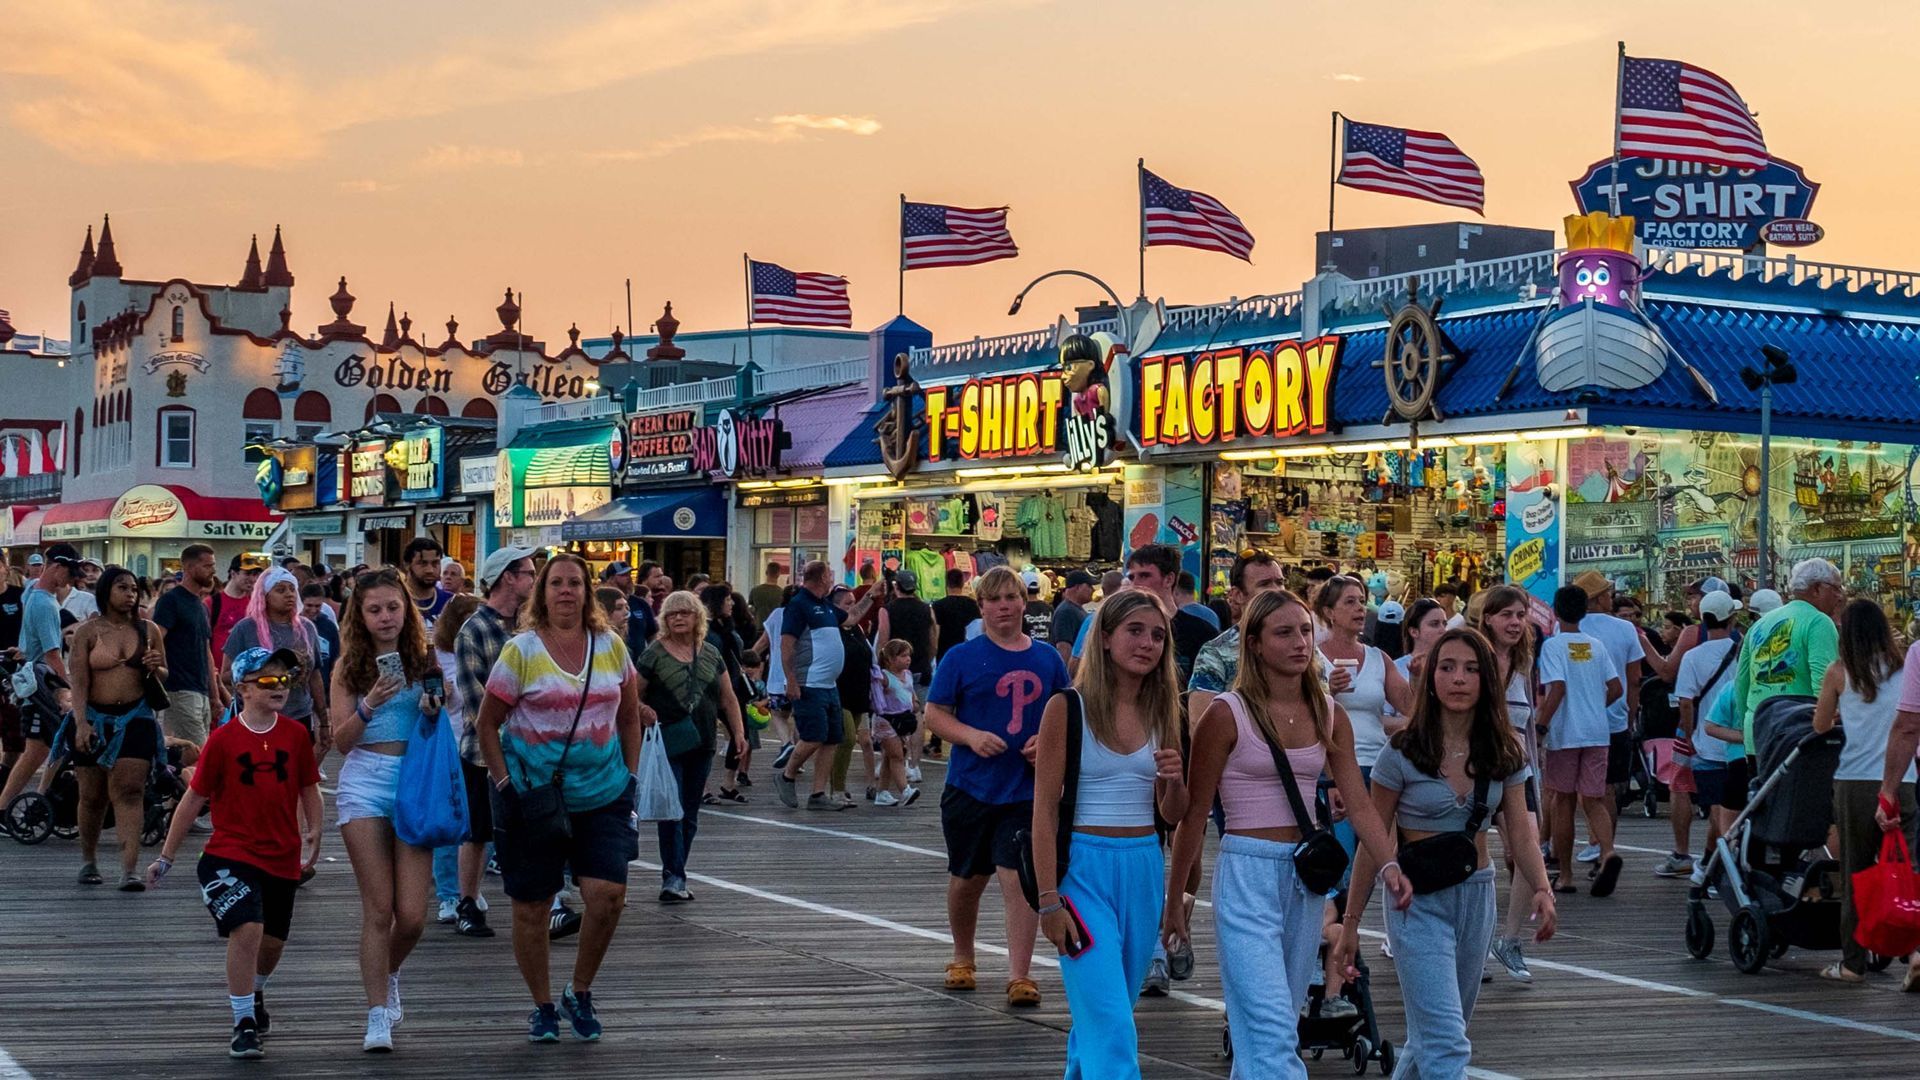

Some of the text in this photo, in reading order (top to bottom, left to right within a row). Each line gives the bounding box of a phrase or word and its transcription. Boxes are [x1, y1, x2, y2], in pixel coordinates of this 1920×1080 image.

[1597, 182, 1796, 219] T-SHIRT
[1643, 222, 1749, 240] FACTORY
[1769, 232, 1816, 242] BATHING SUITS
[1770, 223, 1814, 232] ACTIVE WEAR
[1652, 239, 1738, 248] CUSTOM DECALS
[334, 354, 453, 393] Golden
[1142, 336, 1340, 447] FACTORY
[631, 412, 691, 435] OCEAN CITY
[926, 372, 1062, 463] T-SHIRT
[631, 437, 670, 457] COFFEE
[692, 427, 716, 470] BAD
[204, 522, 235, 535] Salt
[1170, 518, 1194, 540] SNACKS
[1513, 540, 1540, 565] DRINKS
[1572, 545, 1608, 559] JILLY'S
[1024, 611, 1052, 624] Roasted
[995, 670, 1043, 735] P
